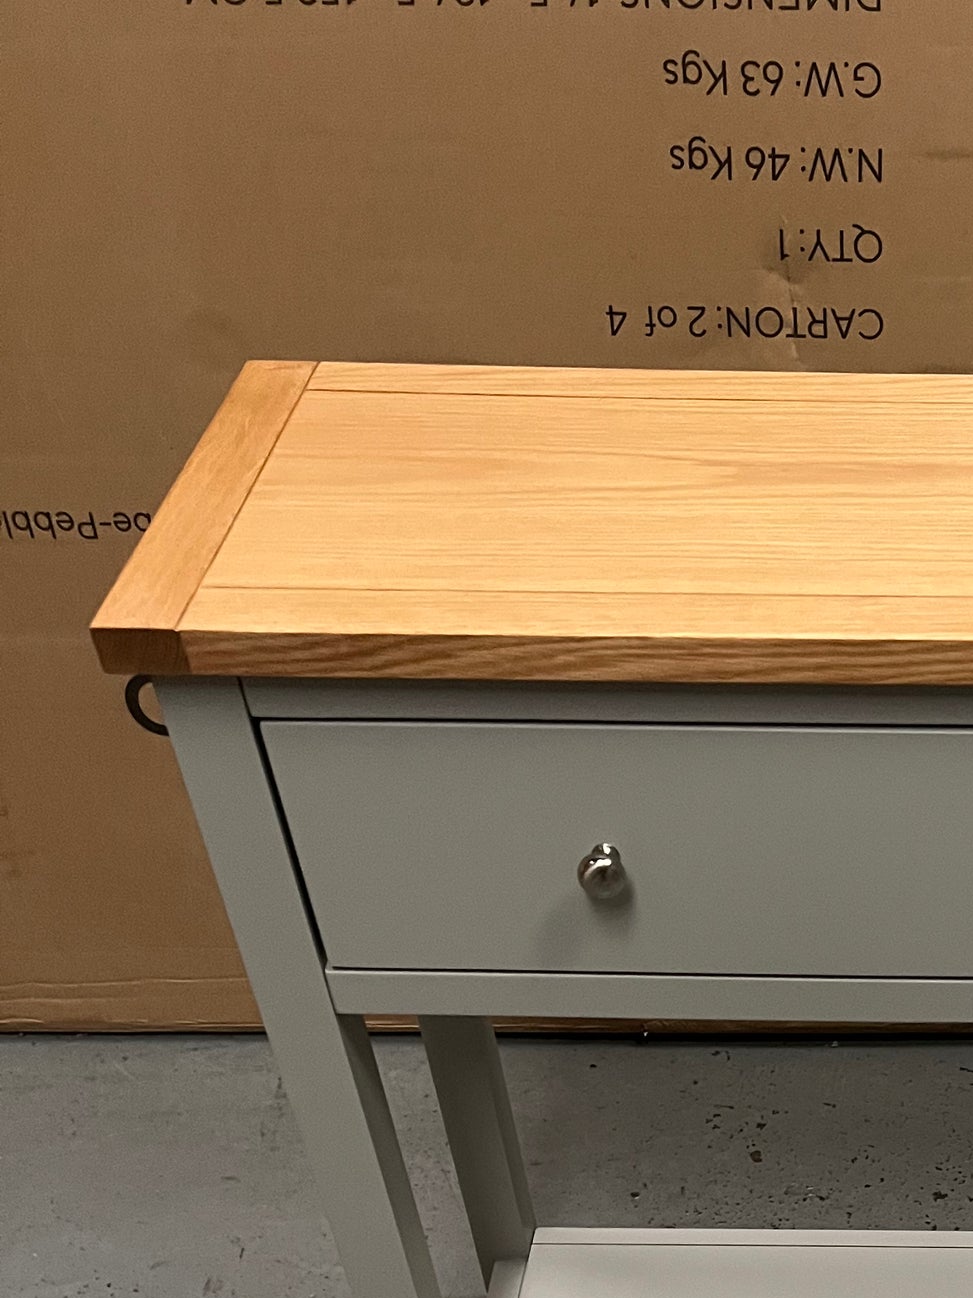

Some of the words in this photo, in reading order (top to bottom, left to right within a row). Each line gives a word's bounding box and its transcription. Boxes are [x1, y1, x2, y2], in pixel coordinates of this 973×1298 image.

[662, 49, 728, 96] Kgs
[740, 60, 784, 97] 63
[794, 60, 882, 98] G.W:
[669, 135, 733, 181] Kgs
[744, 146, 791, 182] 46
[800, 146, 883, 184] N.W:
[799, 223, 883, 264] QTY:
[605, 304, 628, 338] 4
[643, 305, 678, 338] of
[686, 305, 708, 339] 2
[716, 305, 885, 341] CARTON:
